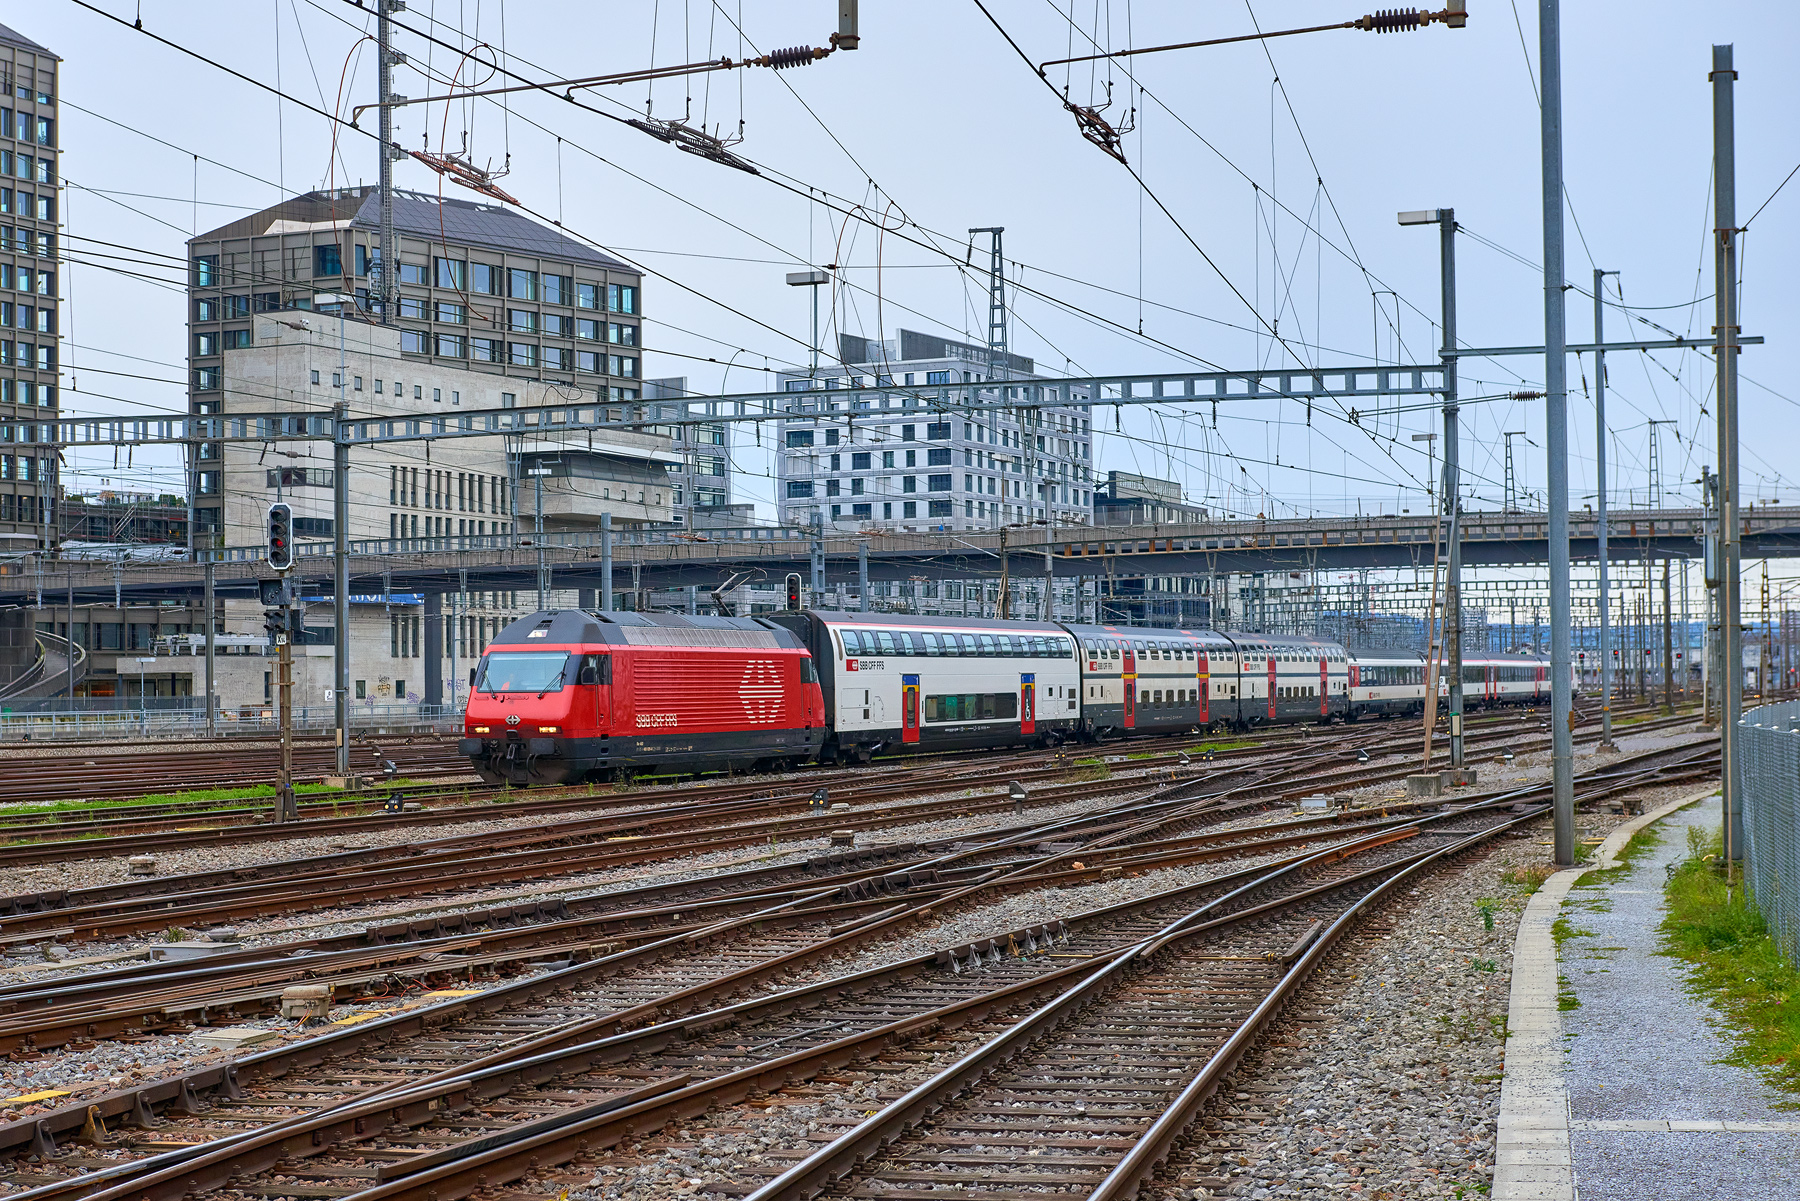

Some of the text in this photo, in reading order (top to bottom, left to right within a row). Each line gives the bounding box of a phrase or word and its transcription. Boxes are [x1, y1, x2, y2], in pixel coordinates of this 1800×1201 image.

[636, 713, 678, 728] SBB CFF FFS
